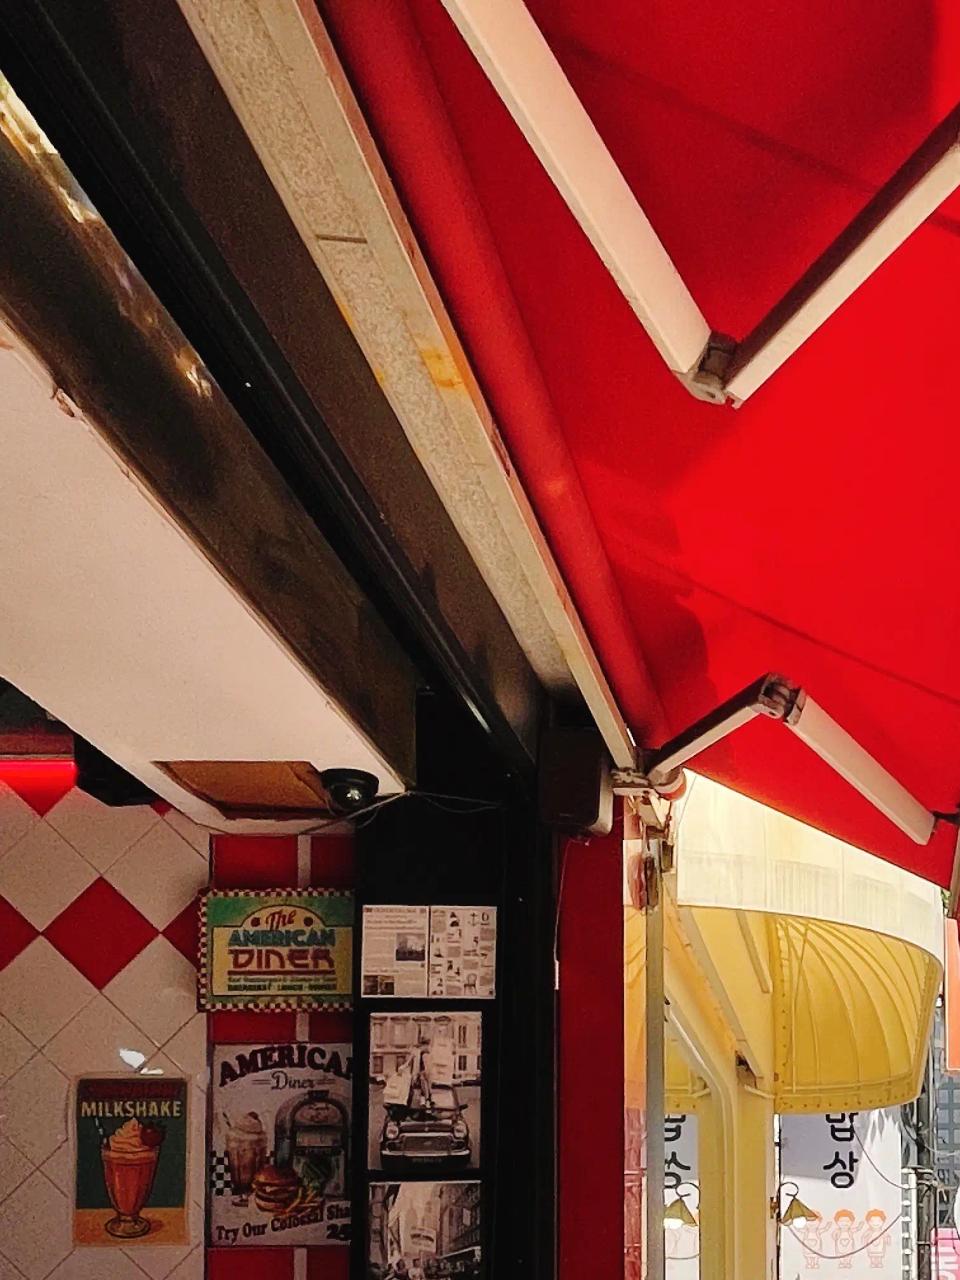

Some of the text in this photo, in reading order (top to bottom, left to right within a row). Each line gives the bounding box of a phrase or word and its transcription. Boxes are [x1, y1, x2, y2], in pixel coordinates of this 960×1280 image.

[266, 909, 297, 932] The
[228, 930, 336, 946] AMERICAN
[228, 948, 335, 969] DINER
[81, 1101, 182, 1117] MILKSHAKE
[216, 1226, 239, 1243] Try
[243, 1222, 268, 1238] Our
